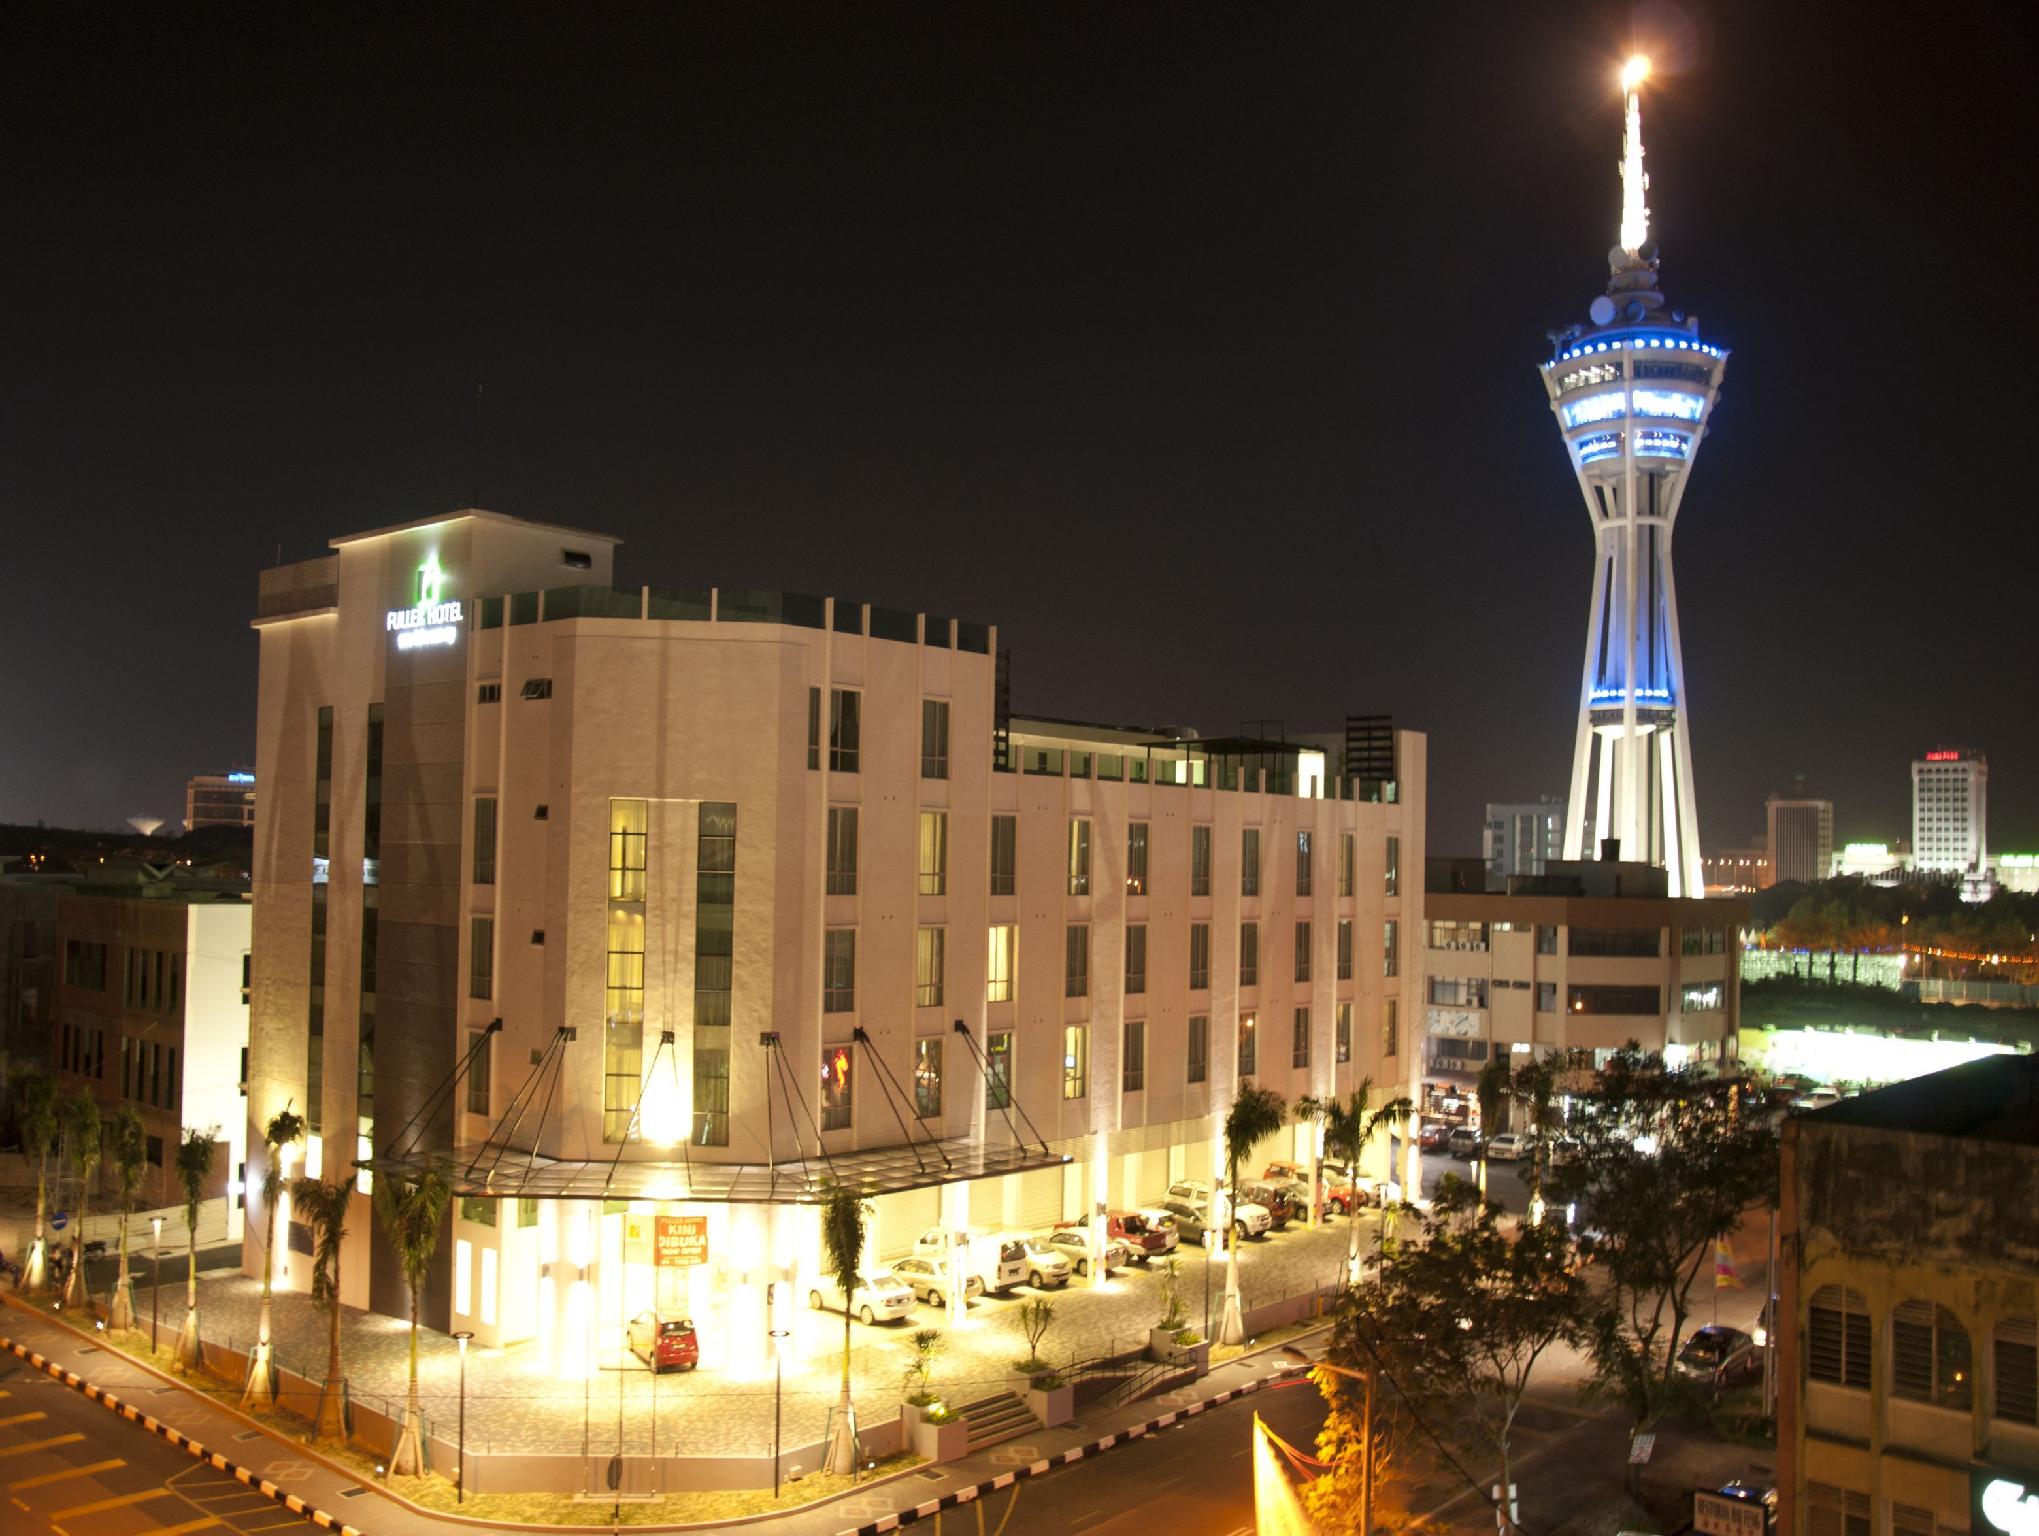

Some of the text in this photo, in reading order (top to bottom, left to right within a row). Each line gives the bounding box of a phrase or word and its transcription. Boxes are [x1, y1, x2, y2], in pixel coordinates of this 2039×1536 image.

[429, 601, 464, 625] HOTEL
[668, 1224, 696, 1235] KINI
[658, 1235, 706, 1247] DIBUKA
